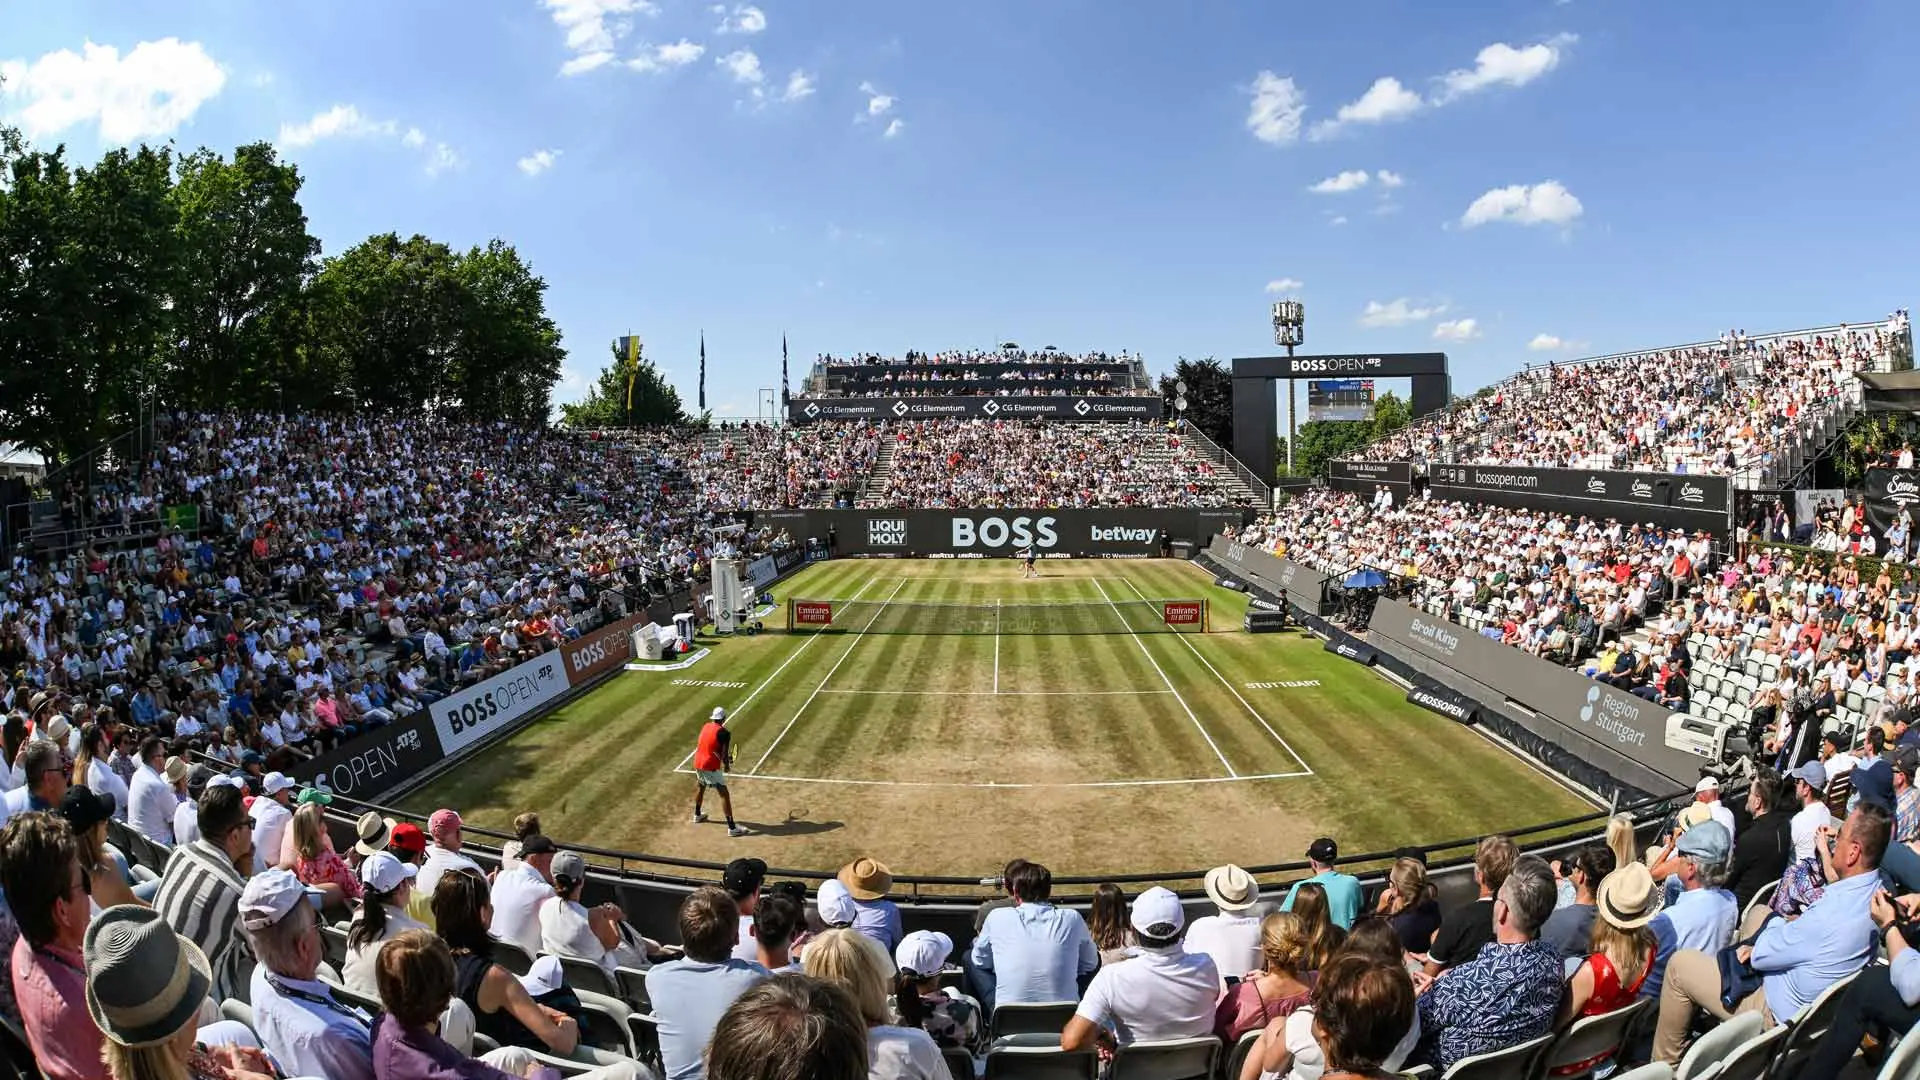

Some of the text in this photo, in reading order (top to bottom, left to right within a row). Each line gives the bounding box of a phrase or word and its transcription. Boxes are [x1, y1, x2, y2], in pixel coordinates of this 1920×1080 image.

[1328, 392, 1368, 400] 4 15
[923, 404, 966, 412] Elementum
[1014, 404, 1057, 412] Elementum
[1093, 404, 1147, 412] CG Elementum
[1475, 469, 1538, 487] bossopen.com
[870, 520, 905, 532] LIQUI
[953, 517, 1057, 547] BOSS
[1091, 525, 1157, 544] betway
[870, 533, 905, 544] MOLY
[1166, 607, 1198, 615] Emirates
[1411, 618, 1436, 637] Broil
[1435, 628, 1459, 650] King
[671, 679, 748, 688] STUTTGART
[1245, 680, 1320, 688] STUTTGART
[1602, 694, 1639, 720] Region
[1595, 712, 1645, 746] Stuttgart
[396, 729, 418, 751] ATP
